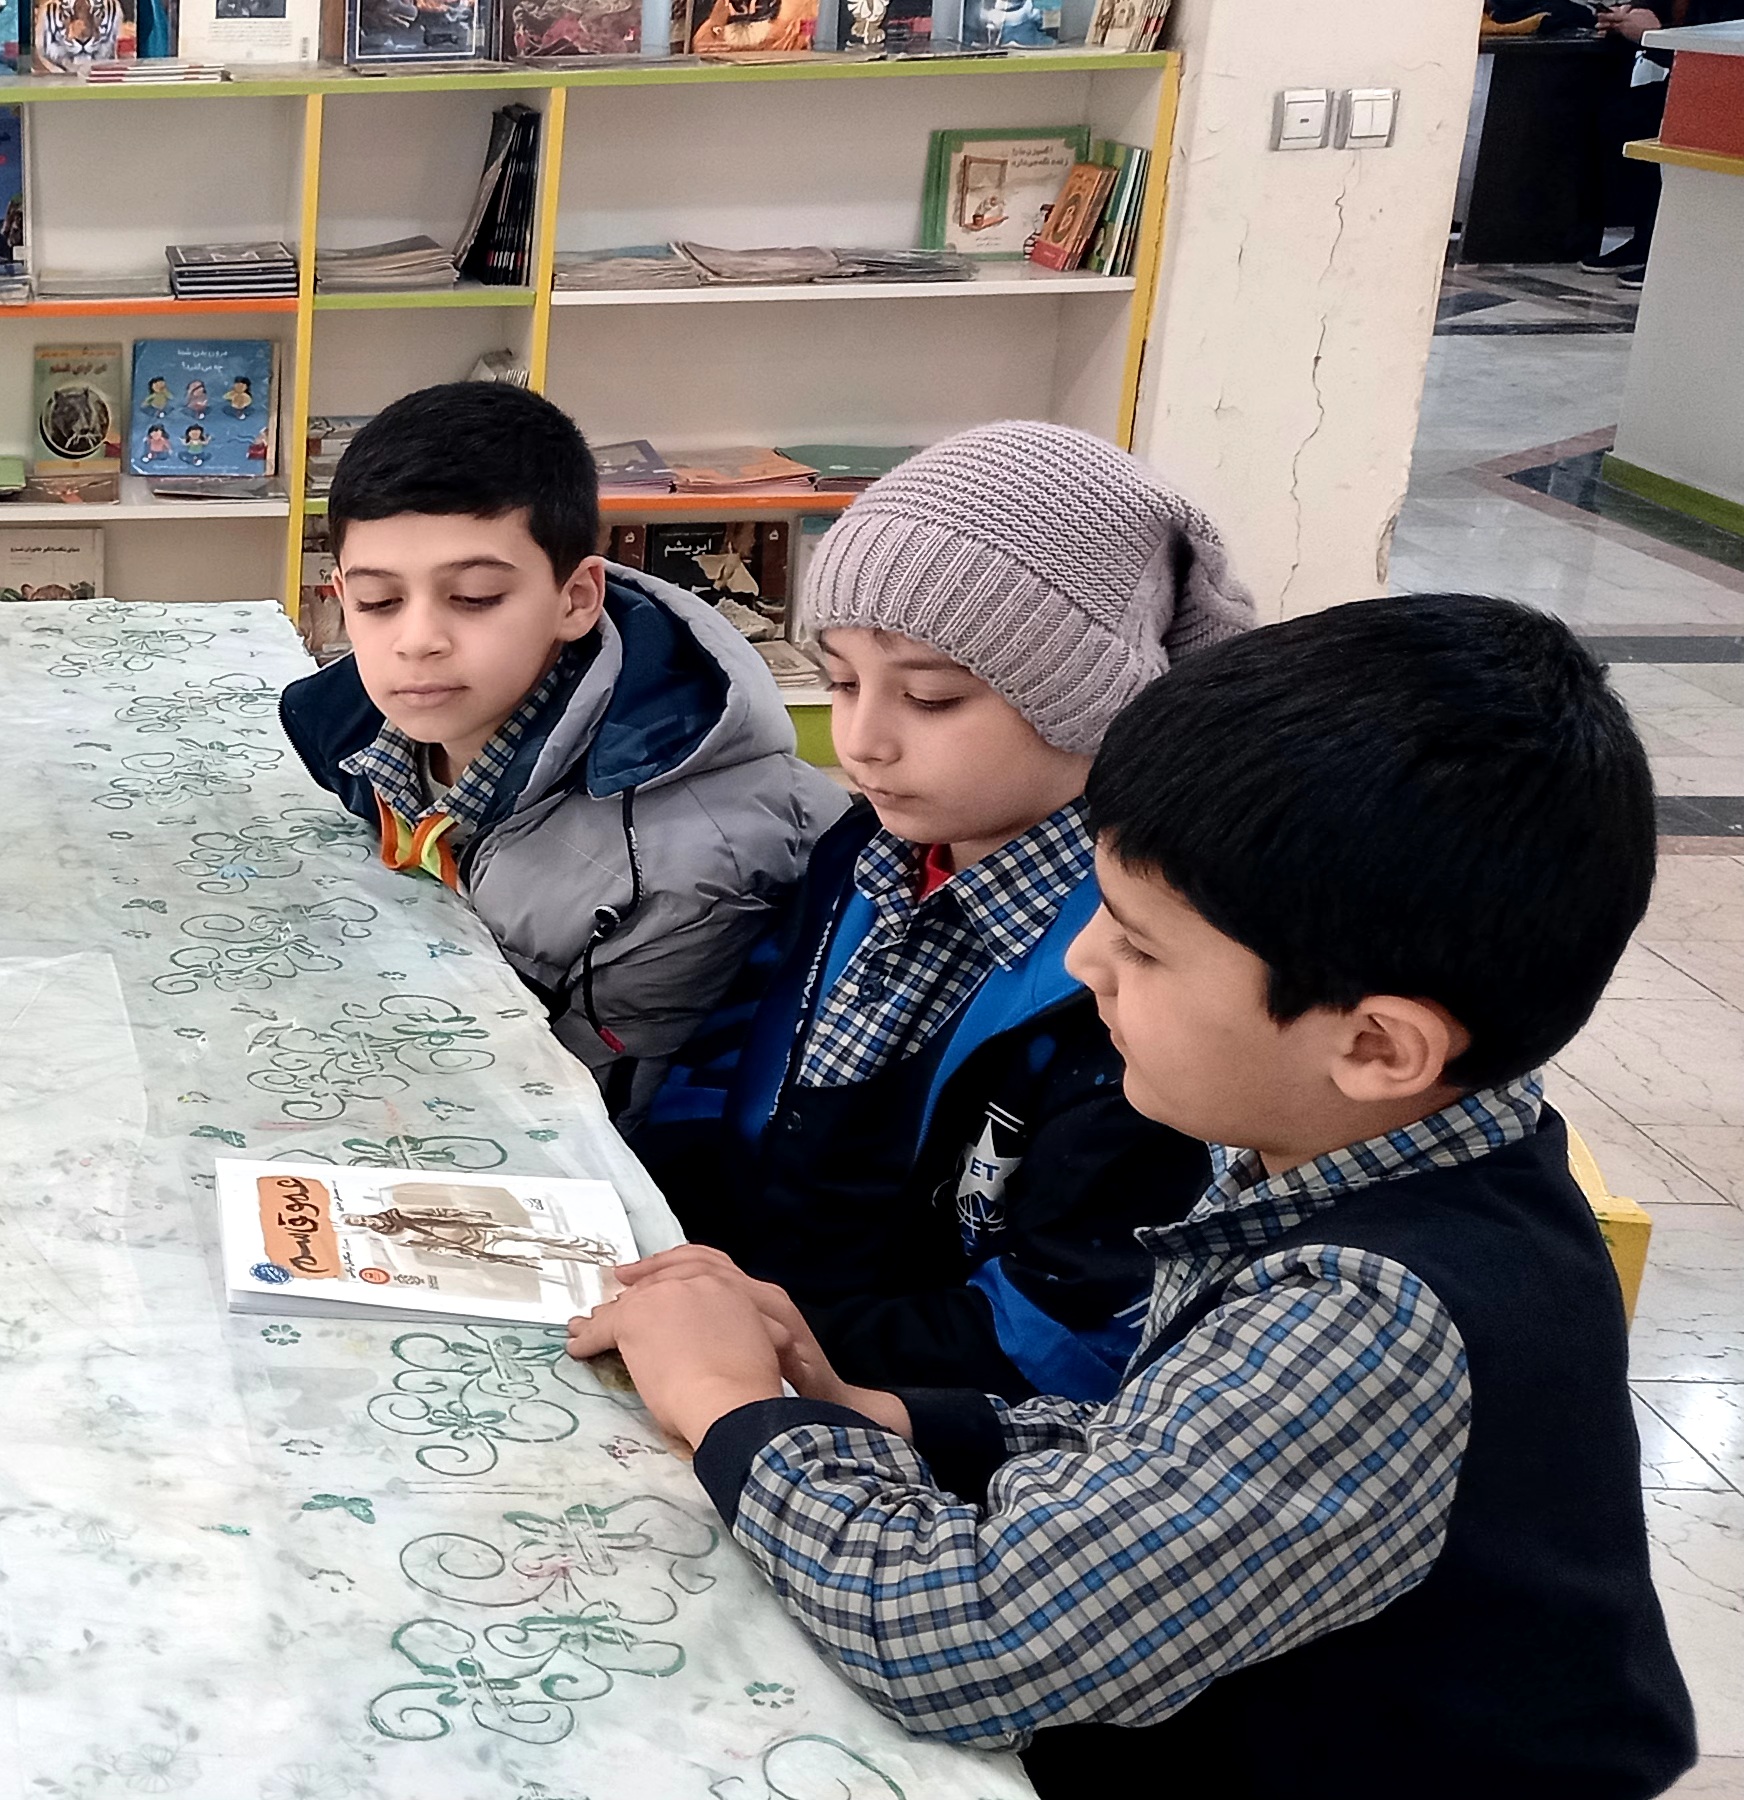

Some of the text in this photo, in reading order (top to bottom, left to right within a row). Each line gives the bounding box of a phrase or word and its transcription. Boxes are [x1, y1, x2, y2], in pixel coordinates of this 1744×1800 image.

[664, 538, 712, 558] ابریشم
[970, 1156, 1001, 1182] ET
[277, 1178, 330, 1273] عمو قاسم
